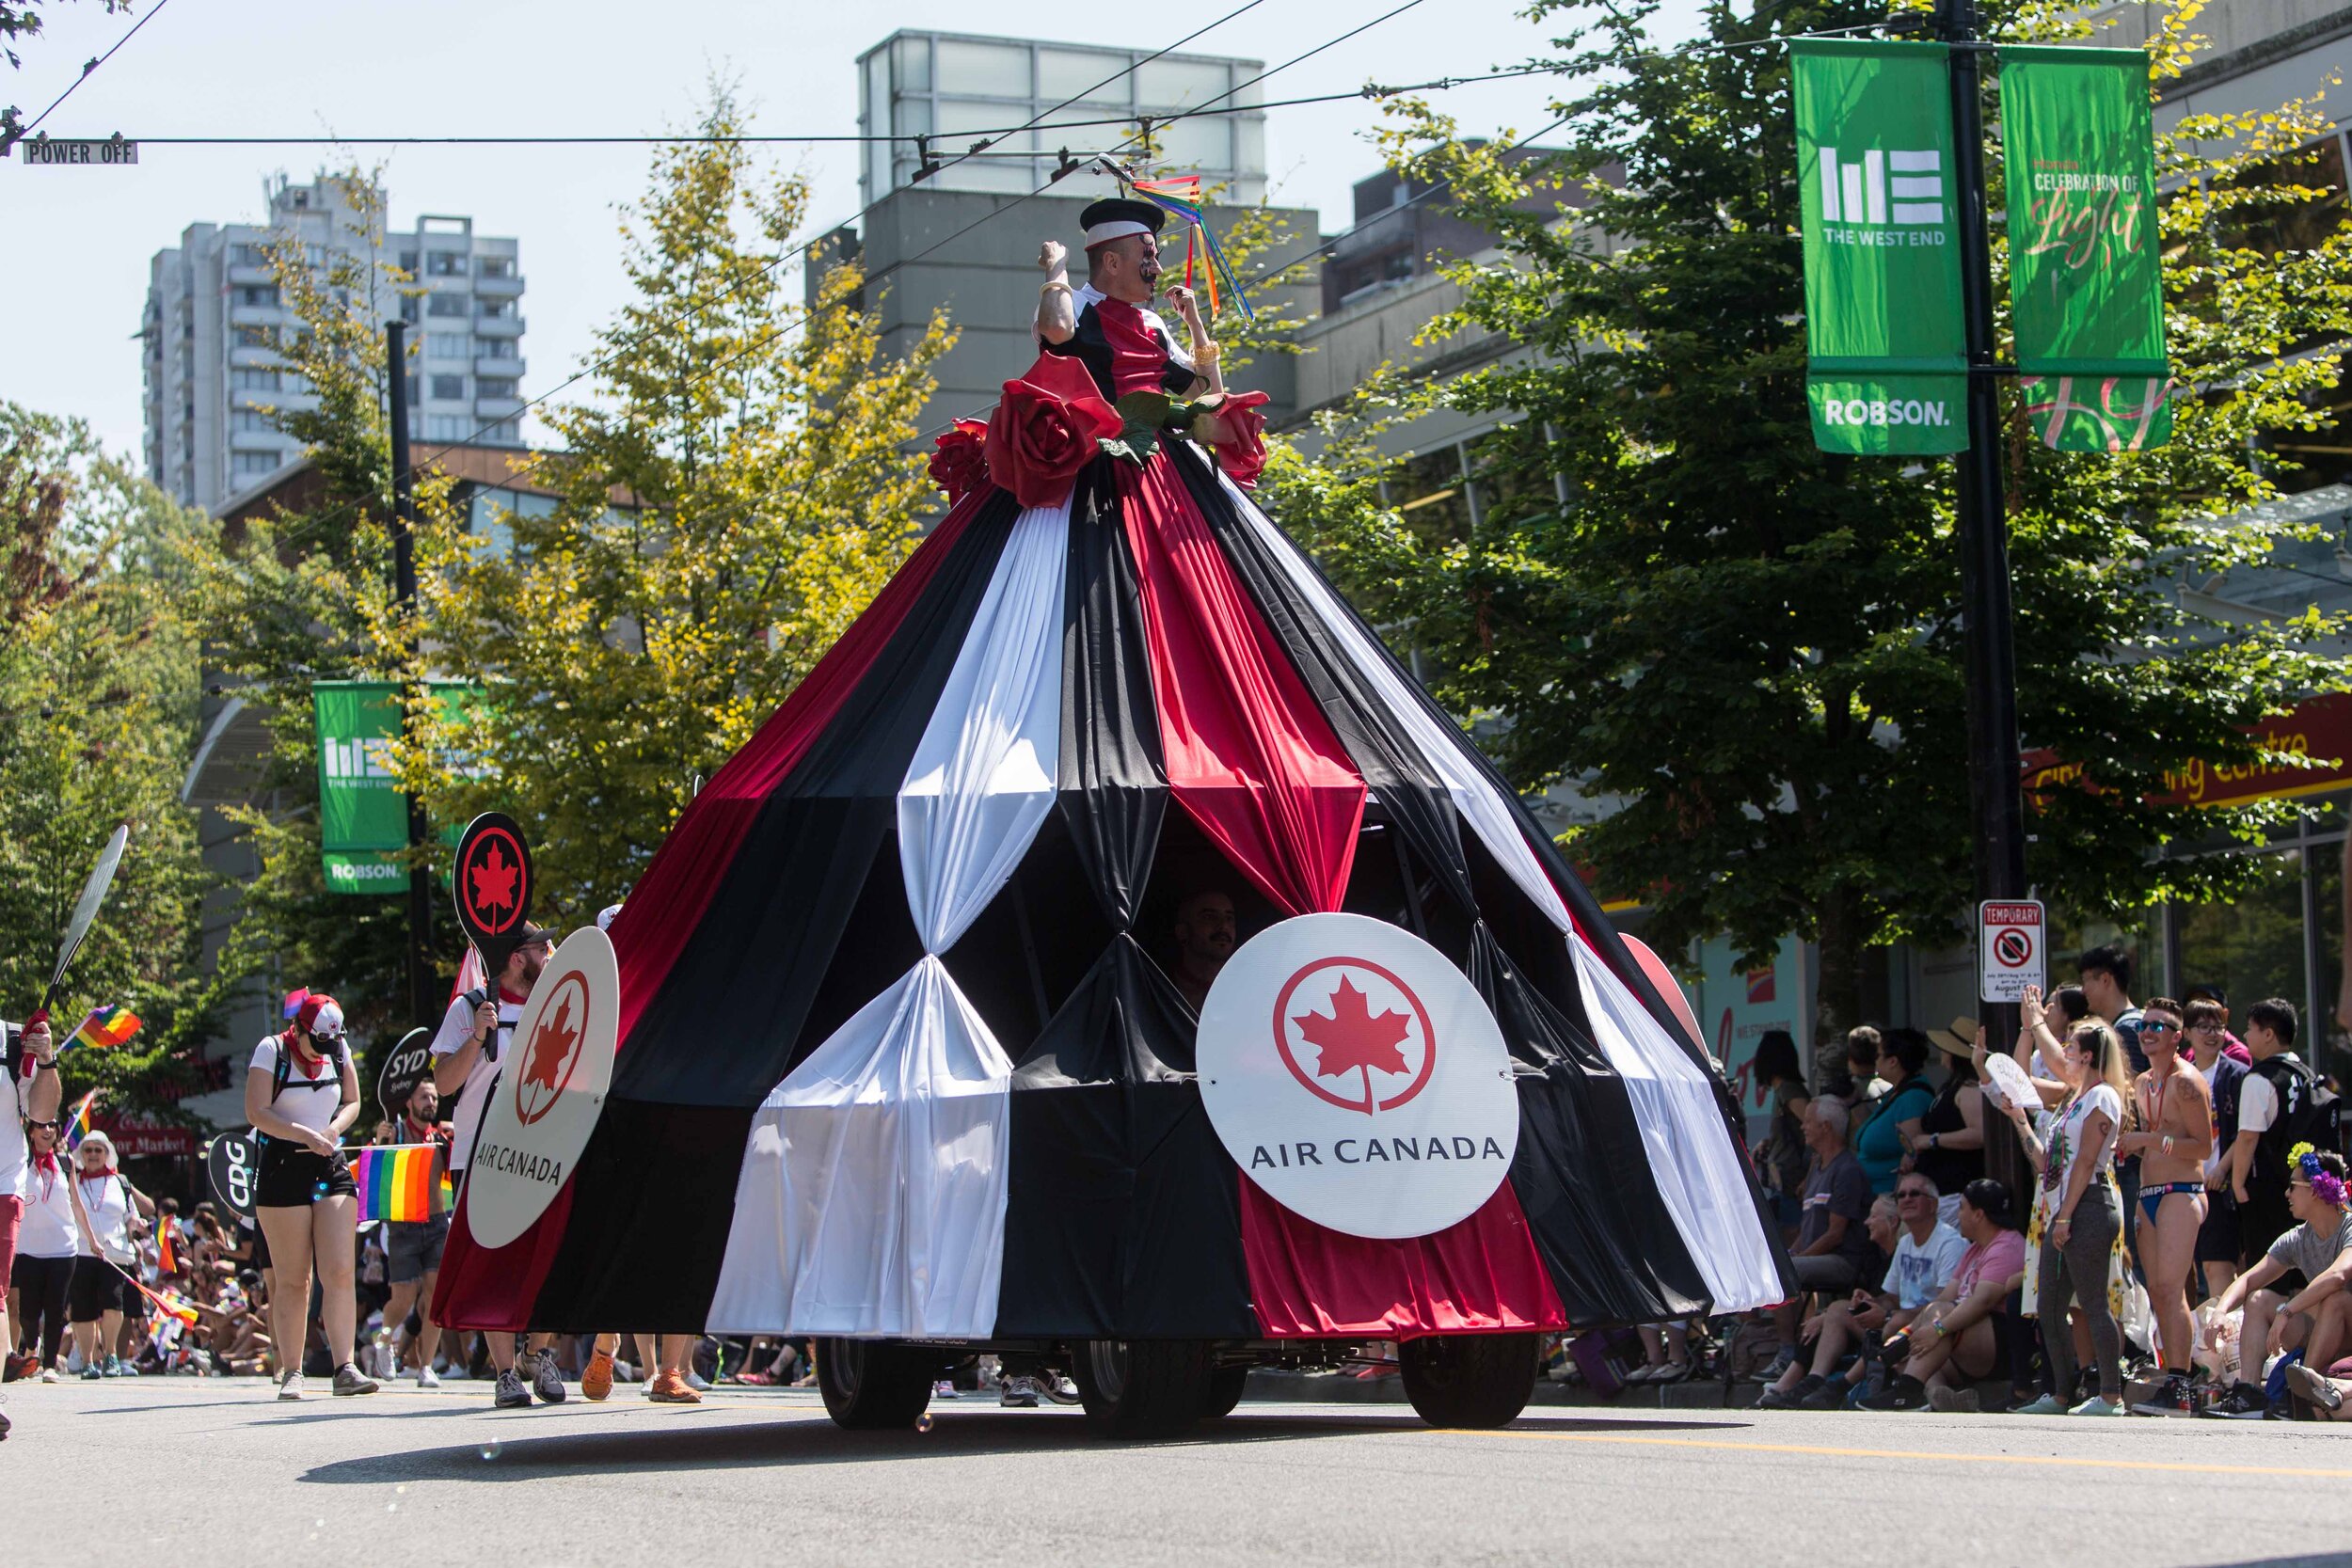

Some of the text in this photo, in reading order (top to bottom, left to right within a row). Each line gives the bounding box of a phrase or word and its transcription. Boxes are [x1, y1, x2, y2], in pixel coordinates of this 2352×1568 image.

[29, 144, 132, 164] POWER OFF
[2034, 172, 2139, 193] CELEBRATION OF
[1822, 228, 1947, 246] THE WEST END
[2025, 186, 2144, 271] Light
[1825, 399, 1950, 426] ROBSON.
[349, 779, 373, 789] WEST
[332, 863, 401, 879] ROBSON.
[1986, 908, 2039, 924] TEMPORARY
[1994, 984, 2021, 993] August
[389, 1049, 427, 1078] SYD
[136, 1136, 185, 1152] Market
[1251, 1136, 1505, 1169] AIR CANADA
[226, 1141, 249, 1208] CDG
[474, 1143, 562, 1186] AIR CANADA
